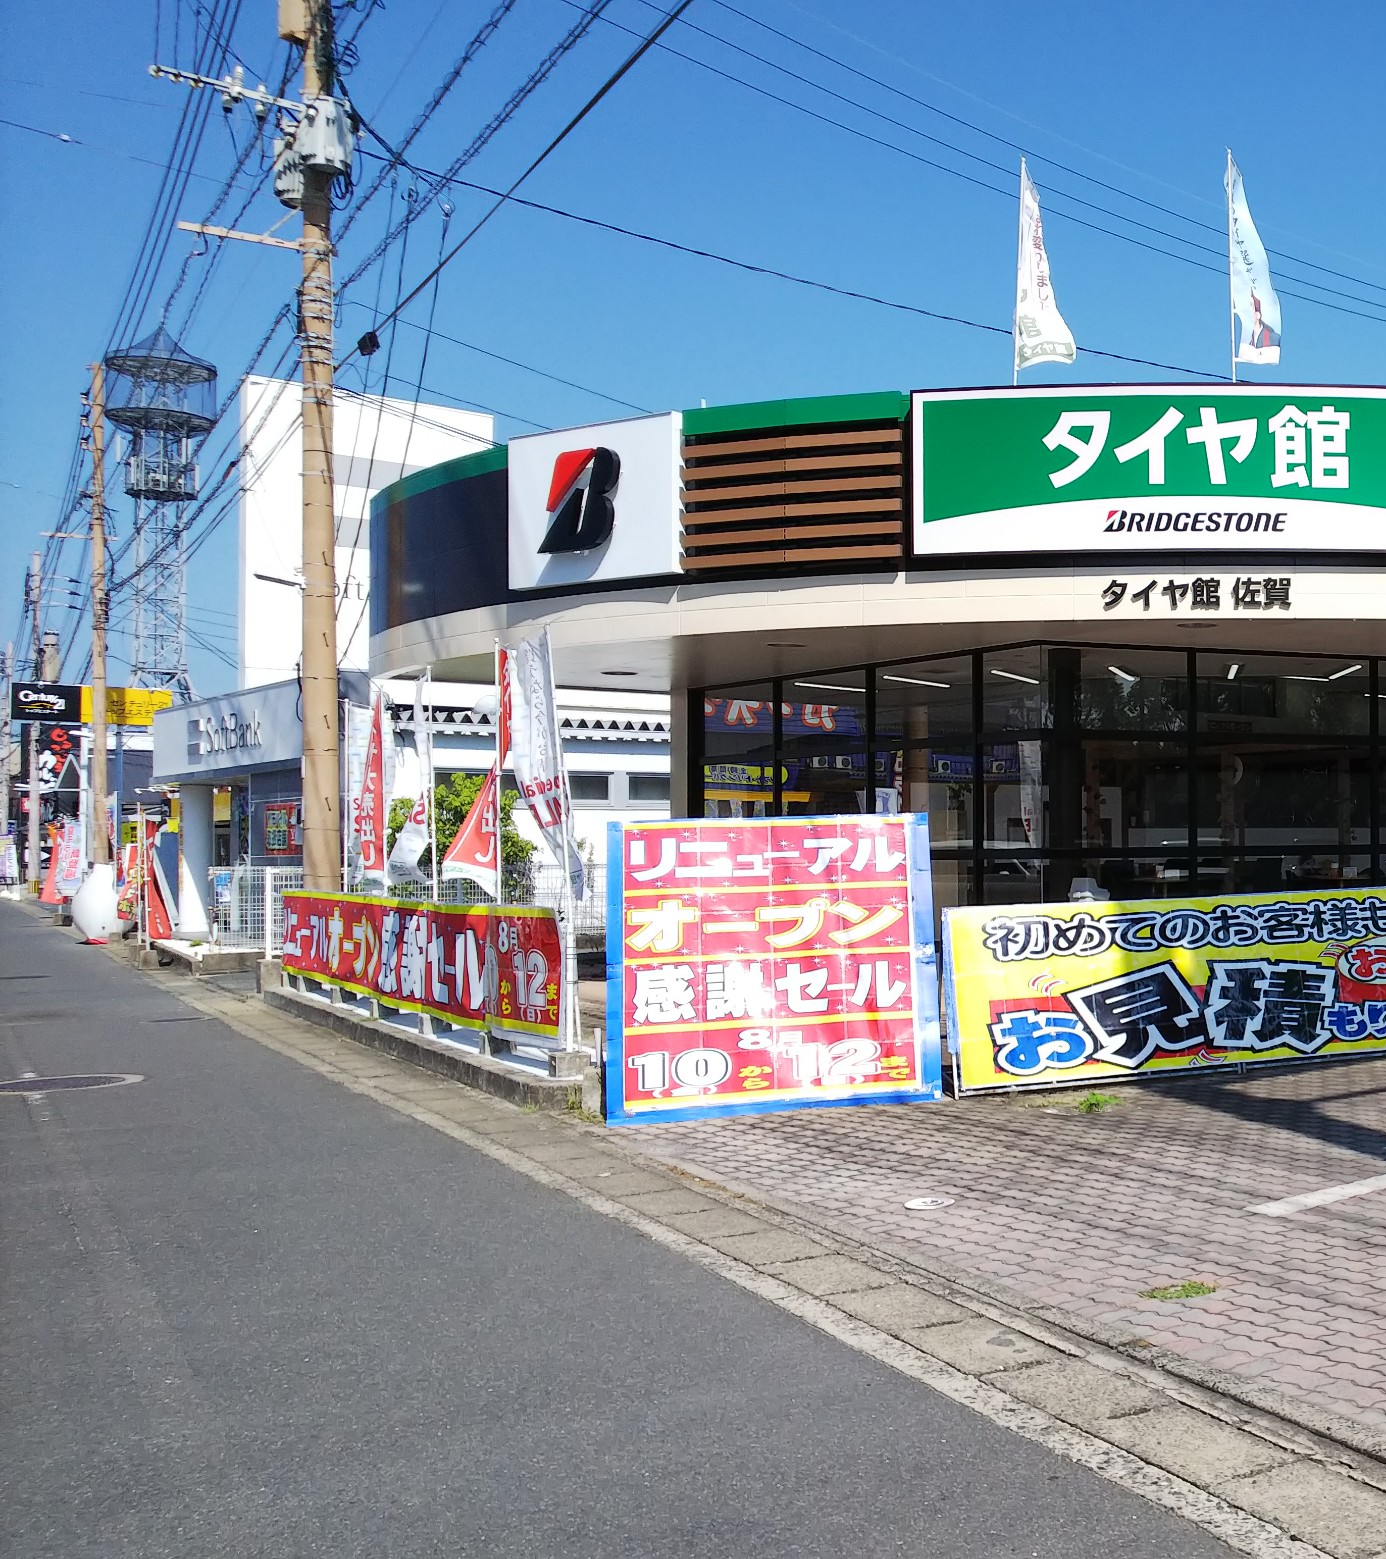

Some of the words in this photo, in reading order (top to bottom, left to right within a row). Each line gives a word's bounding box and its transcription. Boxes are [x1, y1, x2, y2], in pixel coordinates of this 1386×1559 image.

[1041, 404, 1351, 489] タイヤ館
[1102, 509, 1288, 533] BRIDGESTONE
[1101, 577, 1222, 611] タイヤ館
[1231, 577, 1292, 610] 佐賀
[18, 690, 59, 702] Century
[206, 710, 262, 753] SoftBank
[629, 834, 907, 882] リニューアル
[498, 920, 519, 953] 8月
[625, 897, 905, 953] オープン
[500, 979, 512, 1015] から
[512, 948, 548, 1010] 12
[546, 983, 559, 1021] まで
[632, 961, 908, 1025] 感謝セール
[737, 1029, 804, 1054] 8月
[628, 1048, 733, 1092] 10
[738, 1064, 773, 1089] から
[785, 1038, 882, 1082] 12
[880, 1055, 911, 1080] まで
